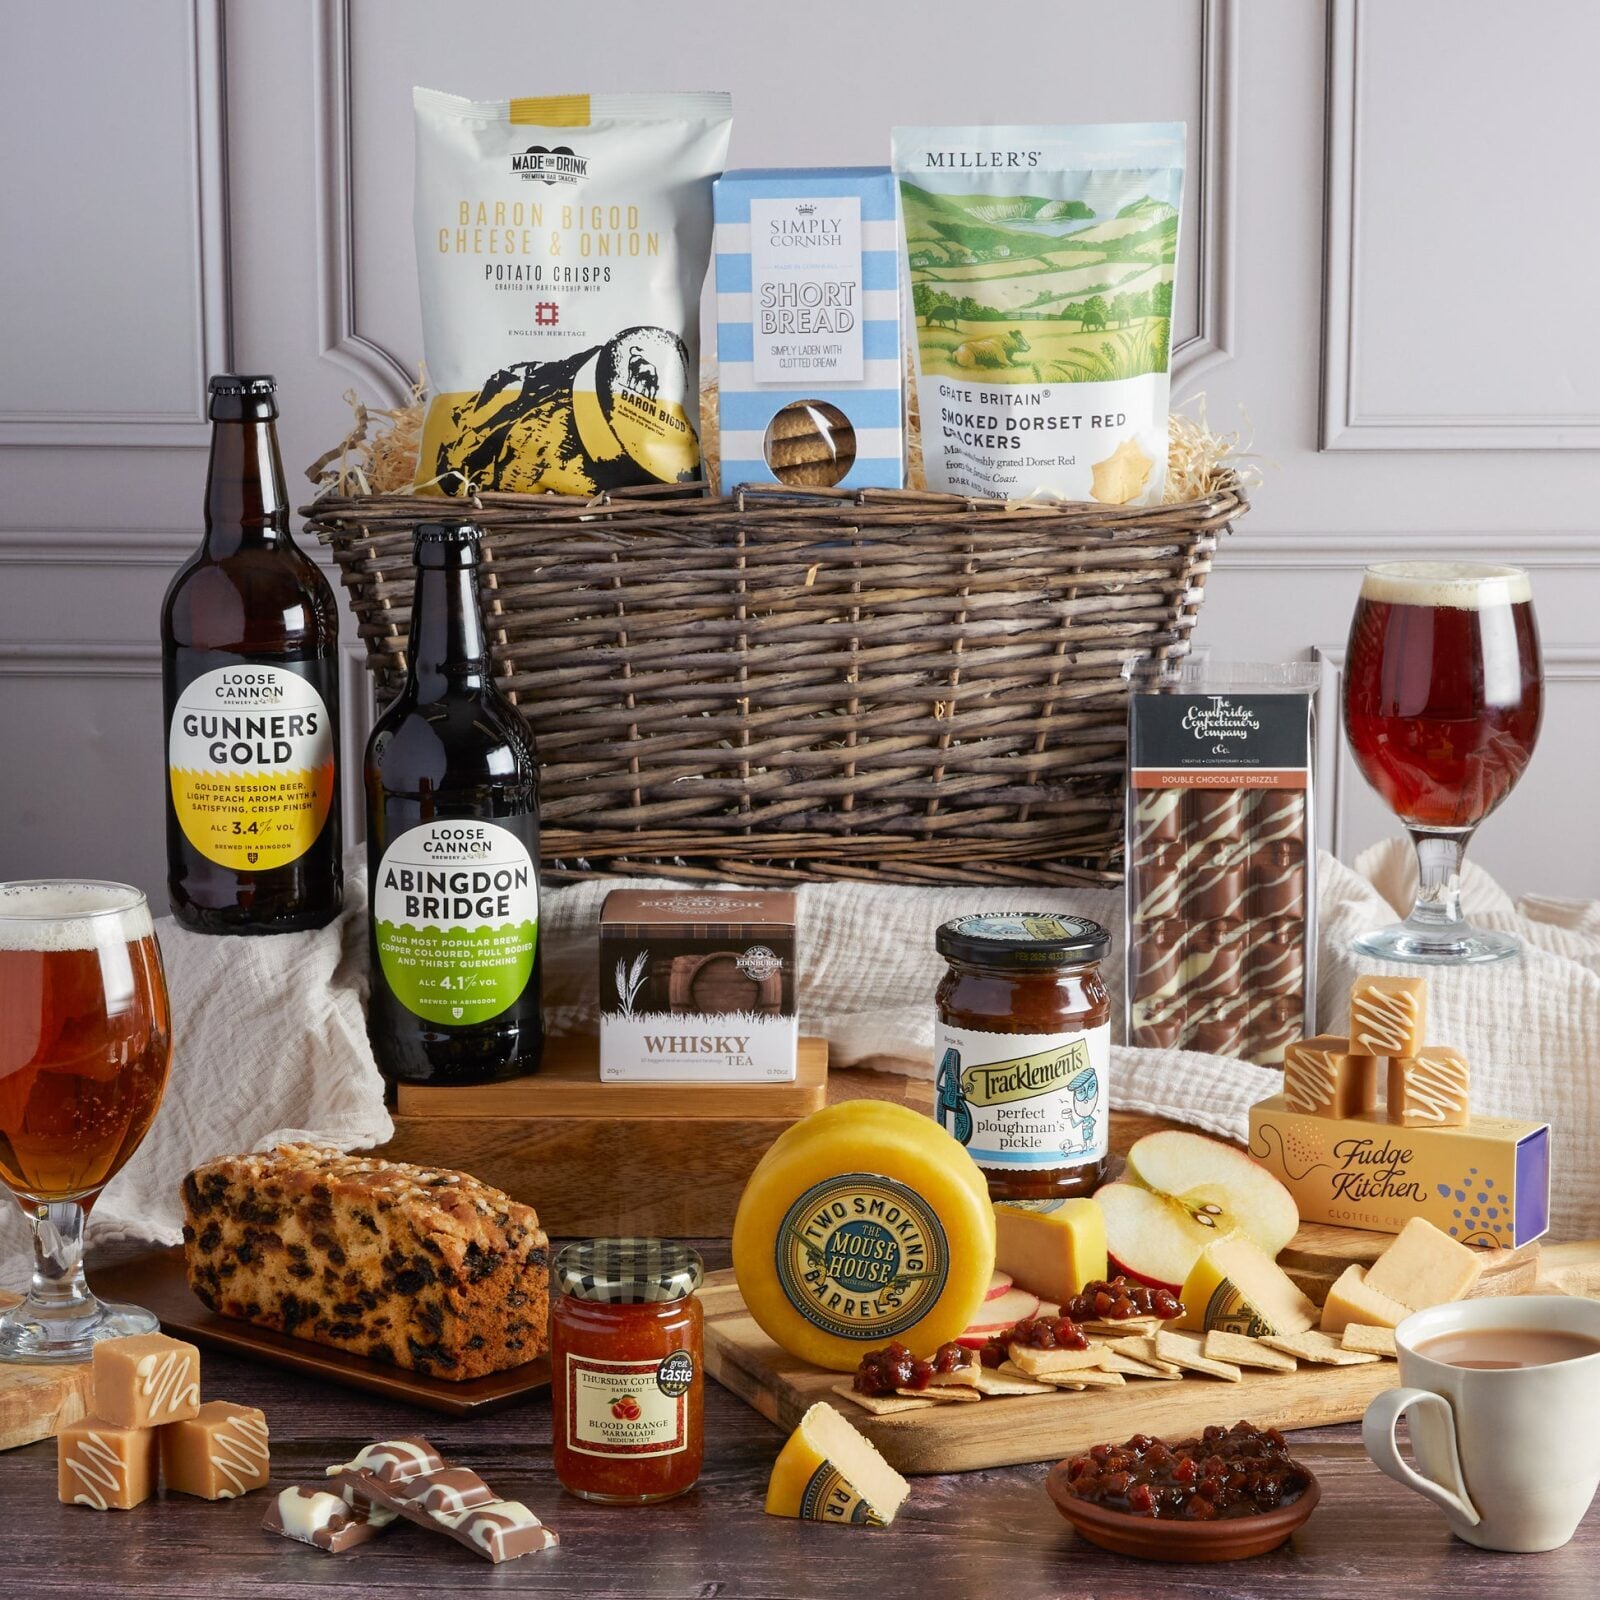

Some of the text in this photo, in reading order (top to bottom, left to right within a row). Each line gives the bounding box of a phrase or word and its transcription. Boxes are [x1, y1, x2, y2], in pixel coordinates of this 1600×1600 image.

[512, 155, 544, 171] MADE
[556, 156, 587, 175] DRINK
[925, 151, 1041, 168] MILLER'S
[459, 200, 639, 230] BARON BIGOD
[770, 219, 842, 234] SIMPLY
[438, 228, 660, 257] CHEESE & ONION
[770, 235, 841, 249] CORNISH
[485, 264, 612, 283] POTATO CRISPS
[536, 284, 581, 292] PARTNERSHIP
[584, 284, 601, 292] WITH
[760, 282, 856, 308] SHORT
[761, 308, 855, 334] BREAD
[771, 345, 842, 356] SIMPLY LADEN WITH
[779, 357, 837, 368] CLOTTED CREAM
[939, 385, 972, 403] GRATE
[621, 389, 686, 433] BARON BIGOD
[941, 408, 1127, 431] SMOKED DORSET RED
[997, 457, 1024, 469] grated
[1026, 457, 1055, 467] Dorset
[1058, 456, 1076, 466] Red
[223, 673, 276, 685] LOOSE
[215, 686, 283, 698] CANNON
[1207, 696, 1231, 710] The
[1188, 705, 1254, 720] Cambridge
[183, 712, 318, 740] GUNNERS
[1182, 716, 1260, 730] Confectionery
[1194, 726, 1247, 740] Company
[209, 741, 292, 765] GOLD
[195, 783, 231, 792] GOLDEN
[1162, 776, 1279, 784] DOUBLE CHOCOLATE DRIZZLE
[187, 791, 317, 803] LIGHT PEACH AROMA WITH A
[192, 802, 312, 814] SATISFYING, CRISP FINISH
[210, 824, 228, 832] ALC
[231, 818, 272, 836] 3.4%
[431, 828, 484, 840] LOOSE
[423, 841, 492, 853] CANNON
[384, 866, 528, 895] ABINGDON
[405, 895, 510, 920] BRIDGE
[390, 935, 408, 945] OUR
[411, 938, 437, 947] MOST
[441, 939, 490, 947] POPULAR
[381, 942, 533, 959] COPPER COLOURED, FULL BODIED
[397, 956, 517, 968] AND THIRST QUENCHING
[736, 959, 782, 967] EDINBURGH
[419, 979, 436, 987] ALC
[439, 973, 478, 992] 4.1%
[643, 1035, 751, 1054] WHISKY
[725, 1055, 754, 1066] TEA
[969, 1044, 1084, 1099] Tracklements
[997, 1108, 1045, 1121] perfect
[977, 1120, 1064, 1136] ploughman's
[1000, 1136, 1042, 1150] pickle
[1333, 1139, 1414, 1181] Fudge
[1331, 1172, 1427, 1202] Kitchen
[1328, 1209, 1408, 1227] CLOTTED CRE
[805, 1197, 924, 1272] TWO SMOKING
[862, 1225, 882, 1237] THE
[830, 1231, 898, 1262] MOUSE
[826, 1255, 892, 1284] HOUSE
[804, 1270, 901, 1317] BARRELS
[670, 1360, 688, 1370] great
[582, 1374, 657, 1386] THURSDAY COTT
[660, 1368, 692, 1382] taste
[589, 1420, 668, 1430] BLOOD ORANGE
[602, 1429, 656, 1437] MARMALADE
